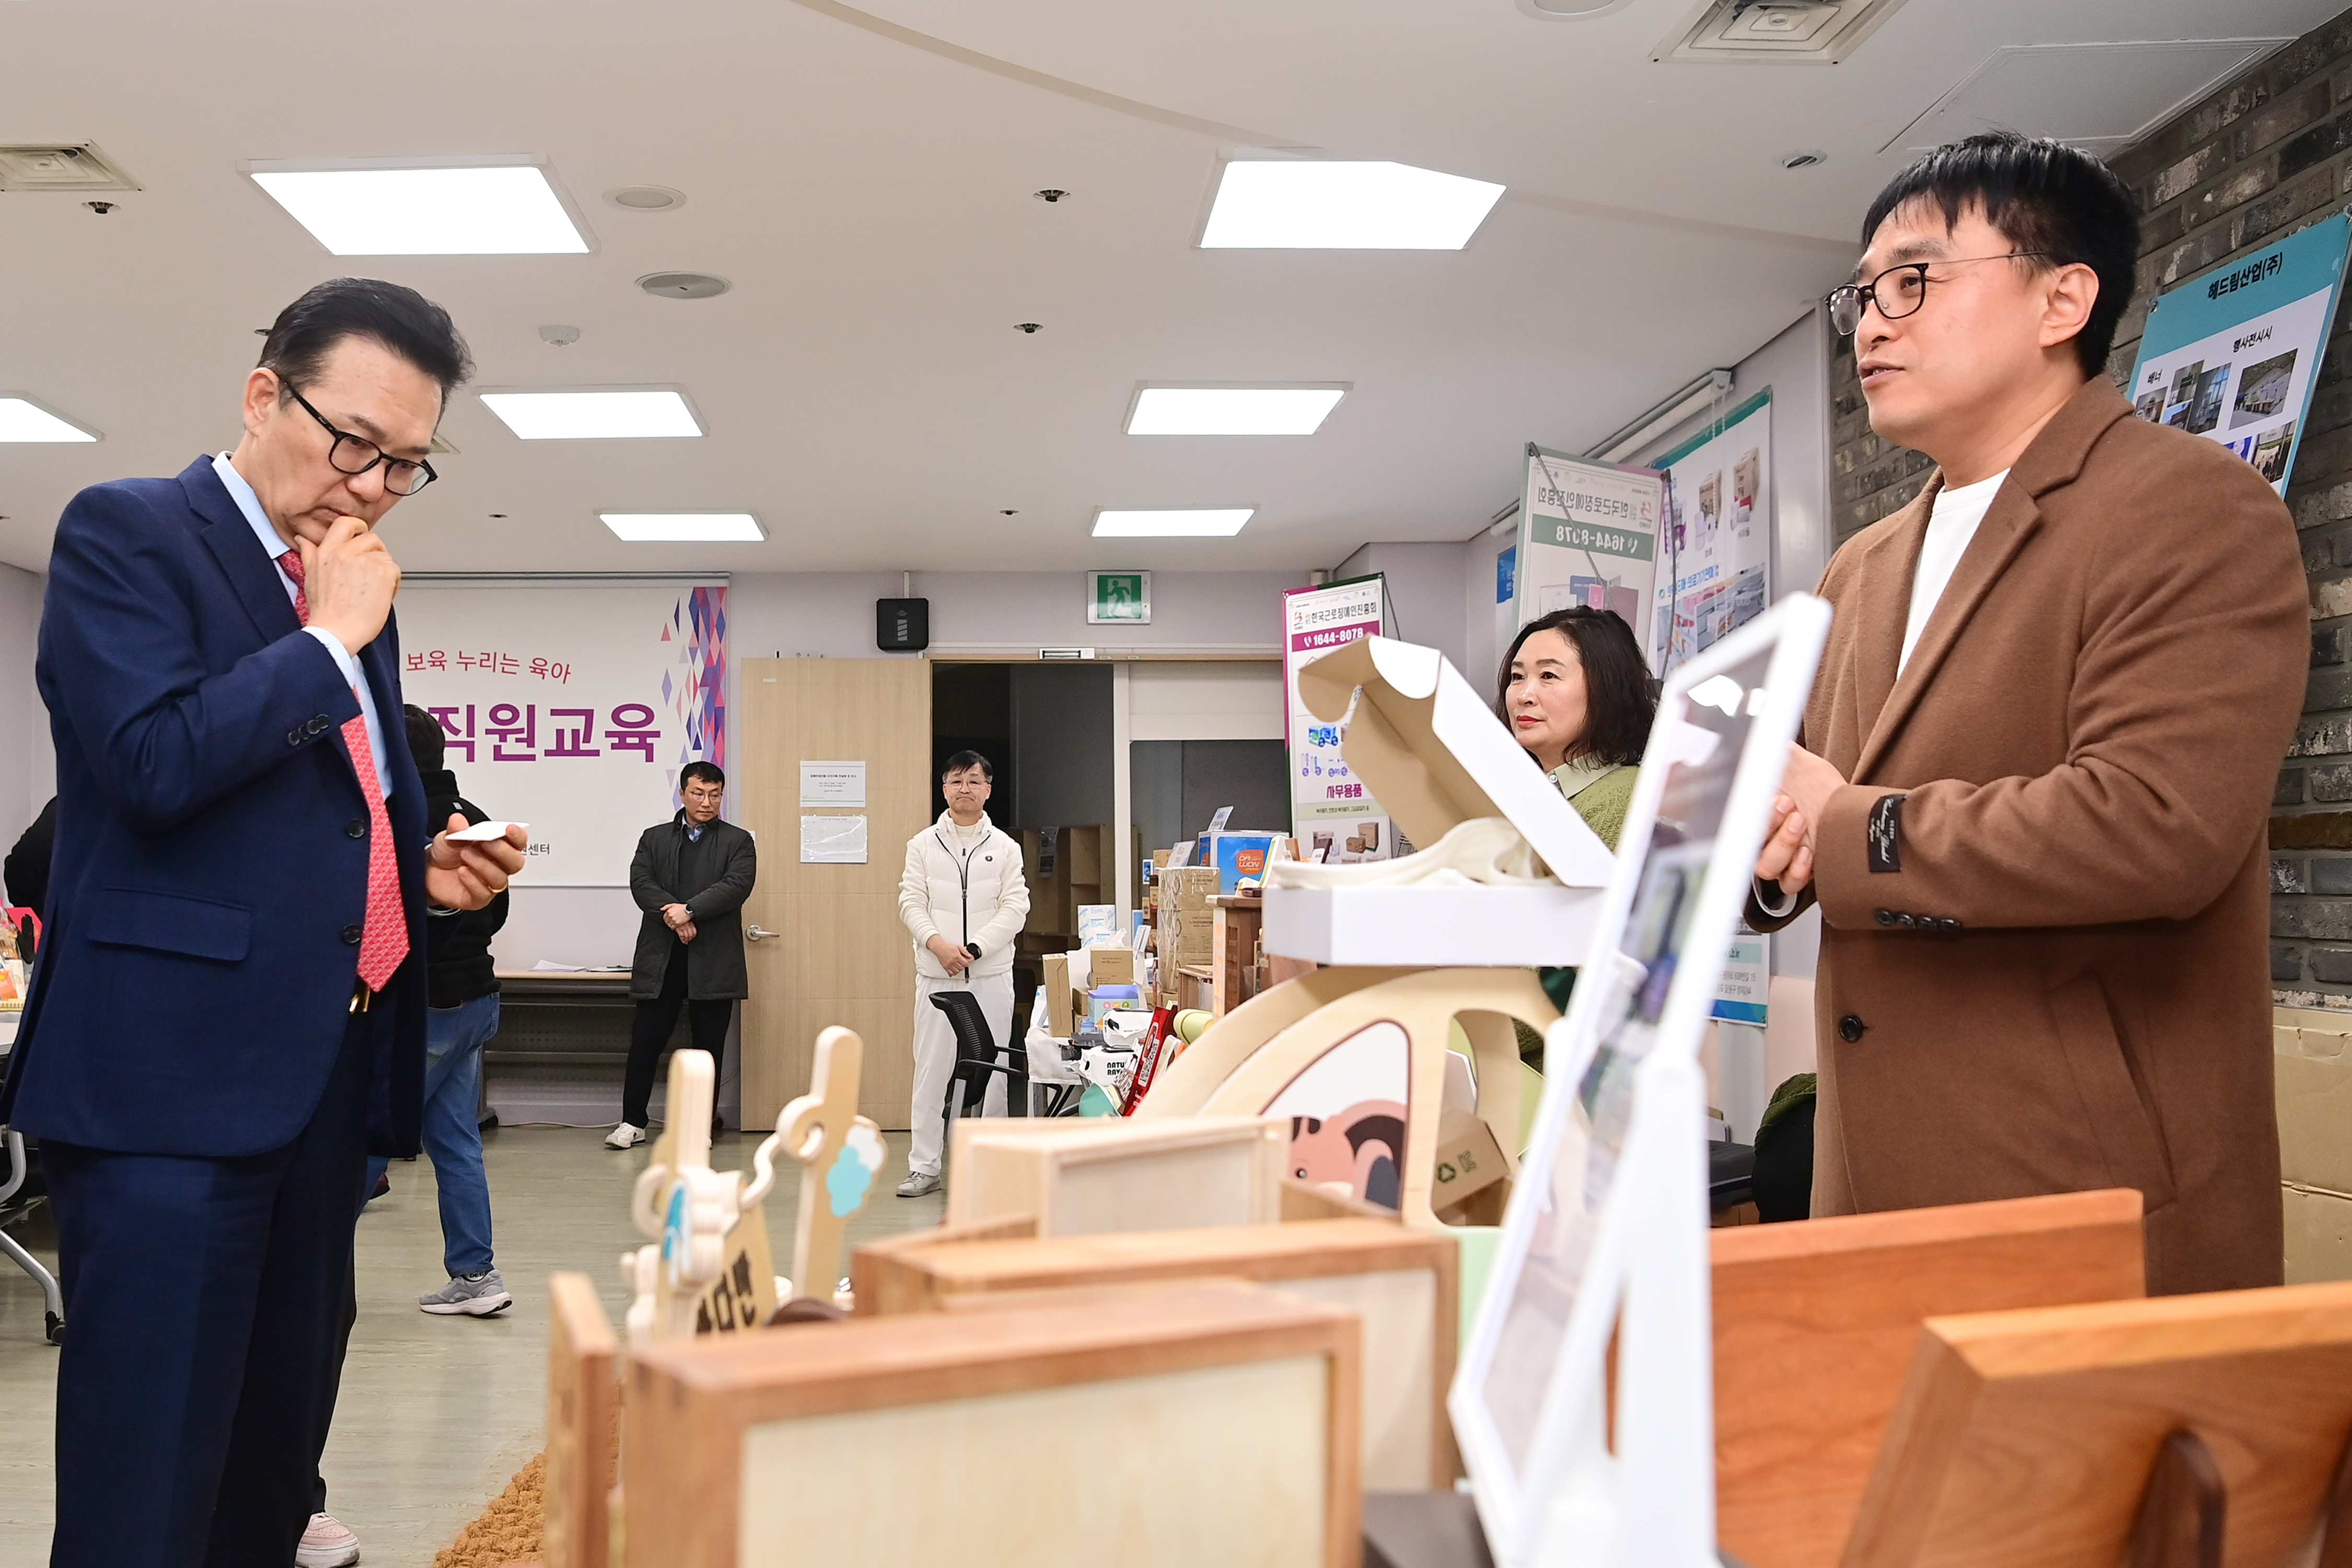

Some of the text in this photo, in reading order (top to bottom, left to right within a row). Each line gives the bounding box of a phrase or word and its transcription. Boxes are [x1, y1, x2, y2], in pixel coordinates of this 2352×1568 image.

[1311, 601, 1377, 624] 한국근로장애인진흥회
[1312, 627, 1364, 646] 1644-8078
[406, 650, 571, 685] 보육 누리는 육아
[428, 703, 661, 763] 직원교육
[1326, 783, 1363, 799] 사무용품
